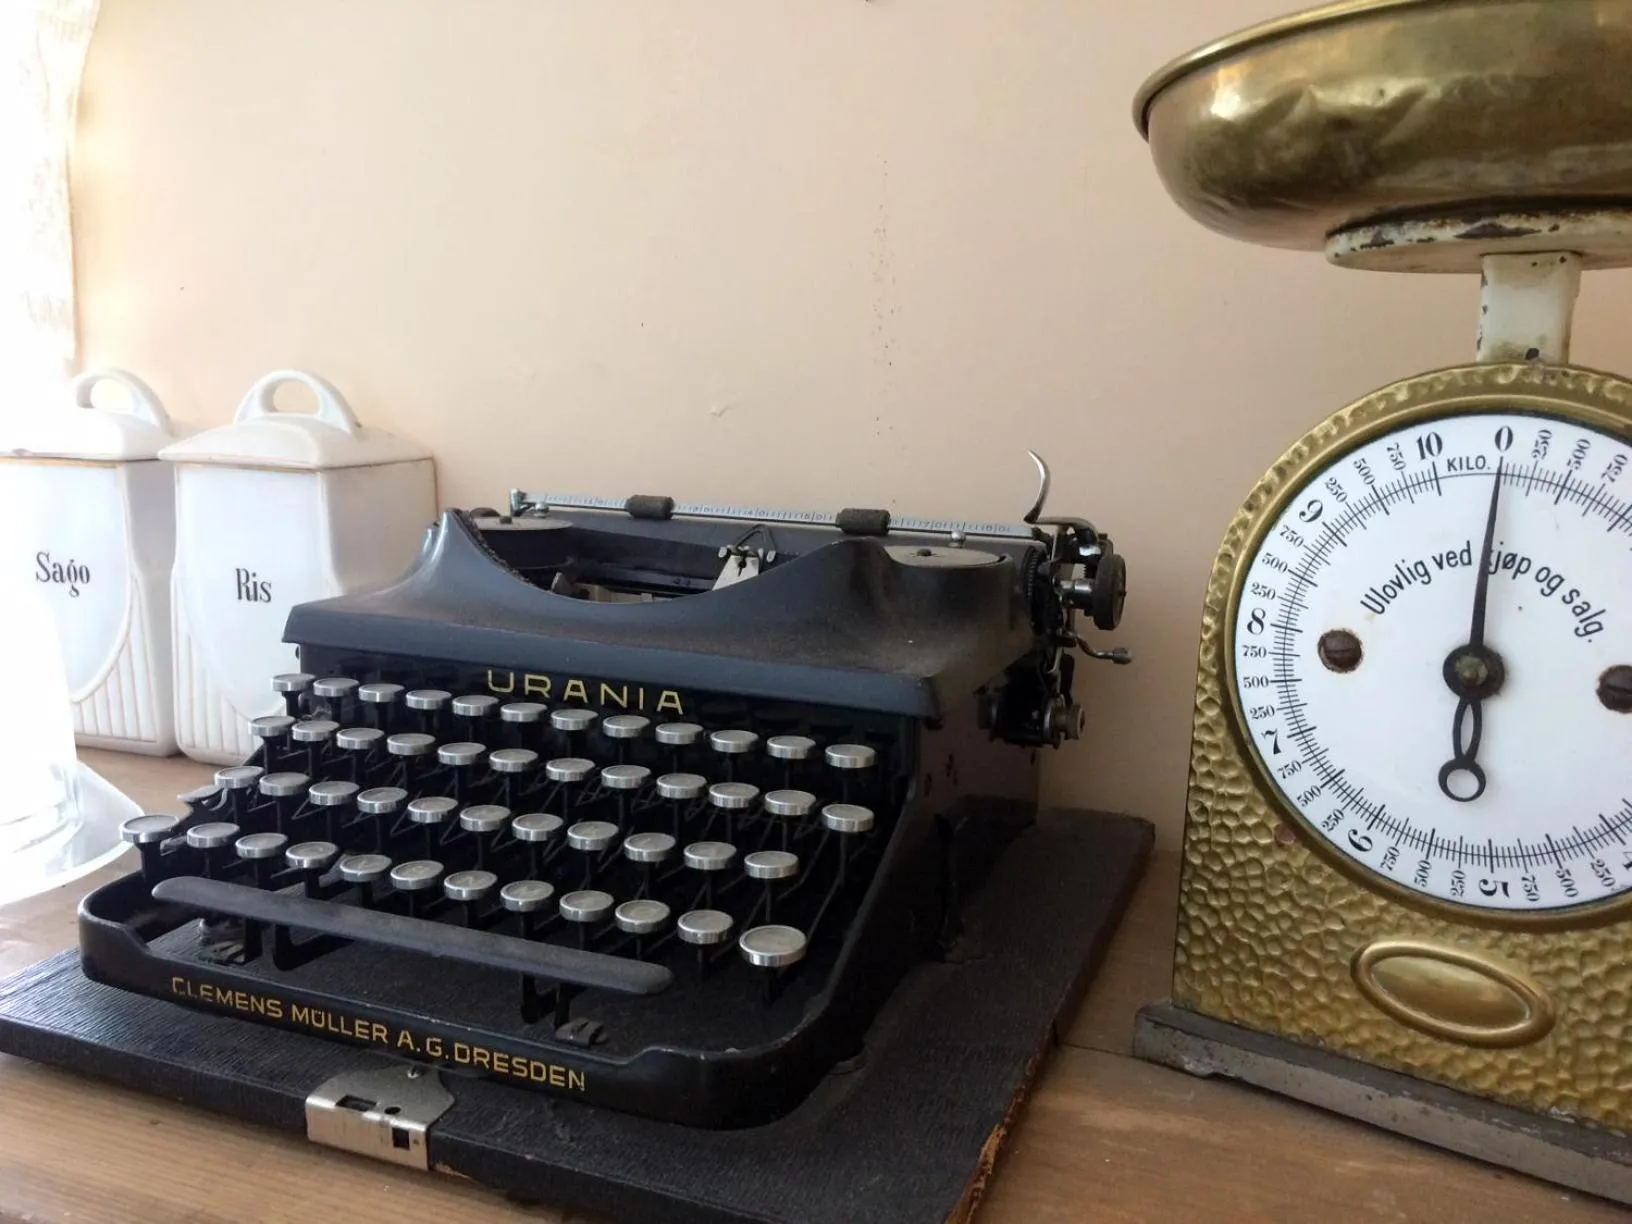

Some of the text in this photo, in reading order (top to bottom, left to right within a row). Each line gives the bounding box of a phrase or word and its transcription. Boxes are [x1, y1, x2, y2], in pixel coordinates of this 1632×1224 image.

[1416, 432, 1443, 460] 10
[1495, 426, 1513, 451] 0
[1532, 429, 1552, 460] 250
[1387, 442, 1407, 471] 750
[1567, 438, 1591, 470] 500
[1353, 458, 1376, 486] 500
[1600, 454, 1628, 483] 750
[1324, 477, 1347, 503] 250
[1299, 499, 1323, 523] 9
[1279, 525, 1304, 548] 750
[36, 551, 91, 598] Sago
[1262, 552, 1288, 574] 500
[235, 567, 272, 603] Ris
[1360, 559, 1432, 615] Ulovlig
[1431, 540, 1472, 570] ved
[1487, 541, 1532, 580] jøp
[1535, 566, 1566, 597] og
[1251, 582, 1276, 601] 250
[1246, 608, 1266, 635] 8
[1242, 644, 1267, 658] 750
[487, 669, 684, 715] URANIA
[1243, 675, 1269, 689] 500
[1250, 705, 1275, 720] 250
[1261, 728, 1282, 755] 7
[1277, 760, 1302, 780] 750
[1297, 785, 1322, 808] 500
[1321, 808, 1345, 832] 250
[1347, 828, 1373, 852] 6
[1380, 846, 1400, 872] 750
[1414, 860, 1433, 888] 500
[1450, 869, 1466, 897] 250
[1556, 868, 1580, 898] 500
[1590, 859, 1617, 887] 250
[1478, 878, 1510, 898] 5
[1521, 874, 1541, 902] 750
[172, 976, 283, 1018] CLEMENS
[291, 1004, 388, 1043] MÜLLER
